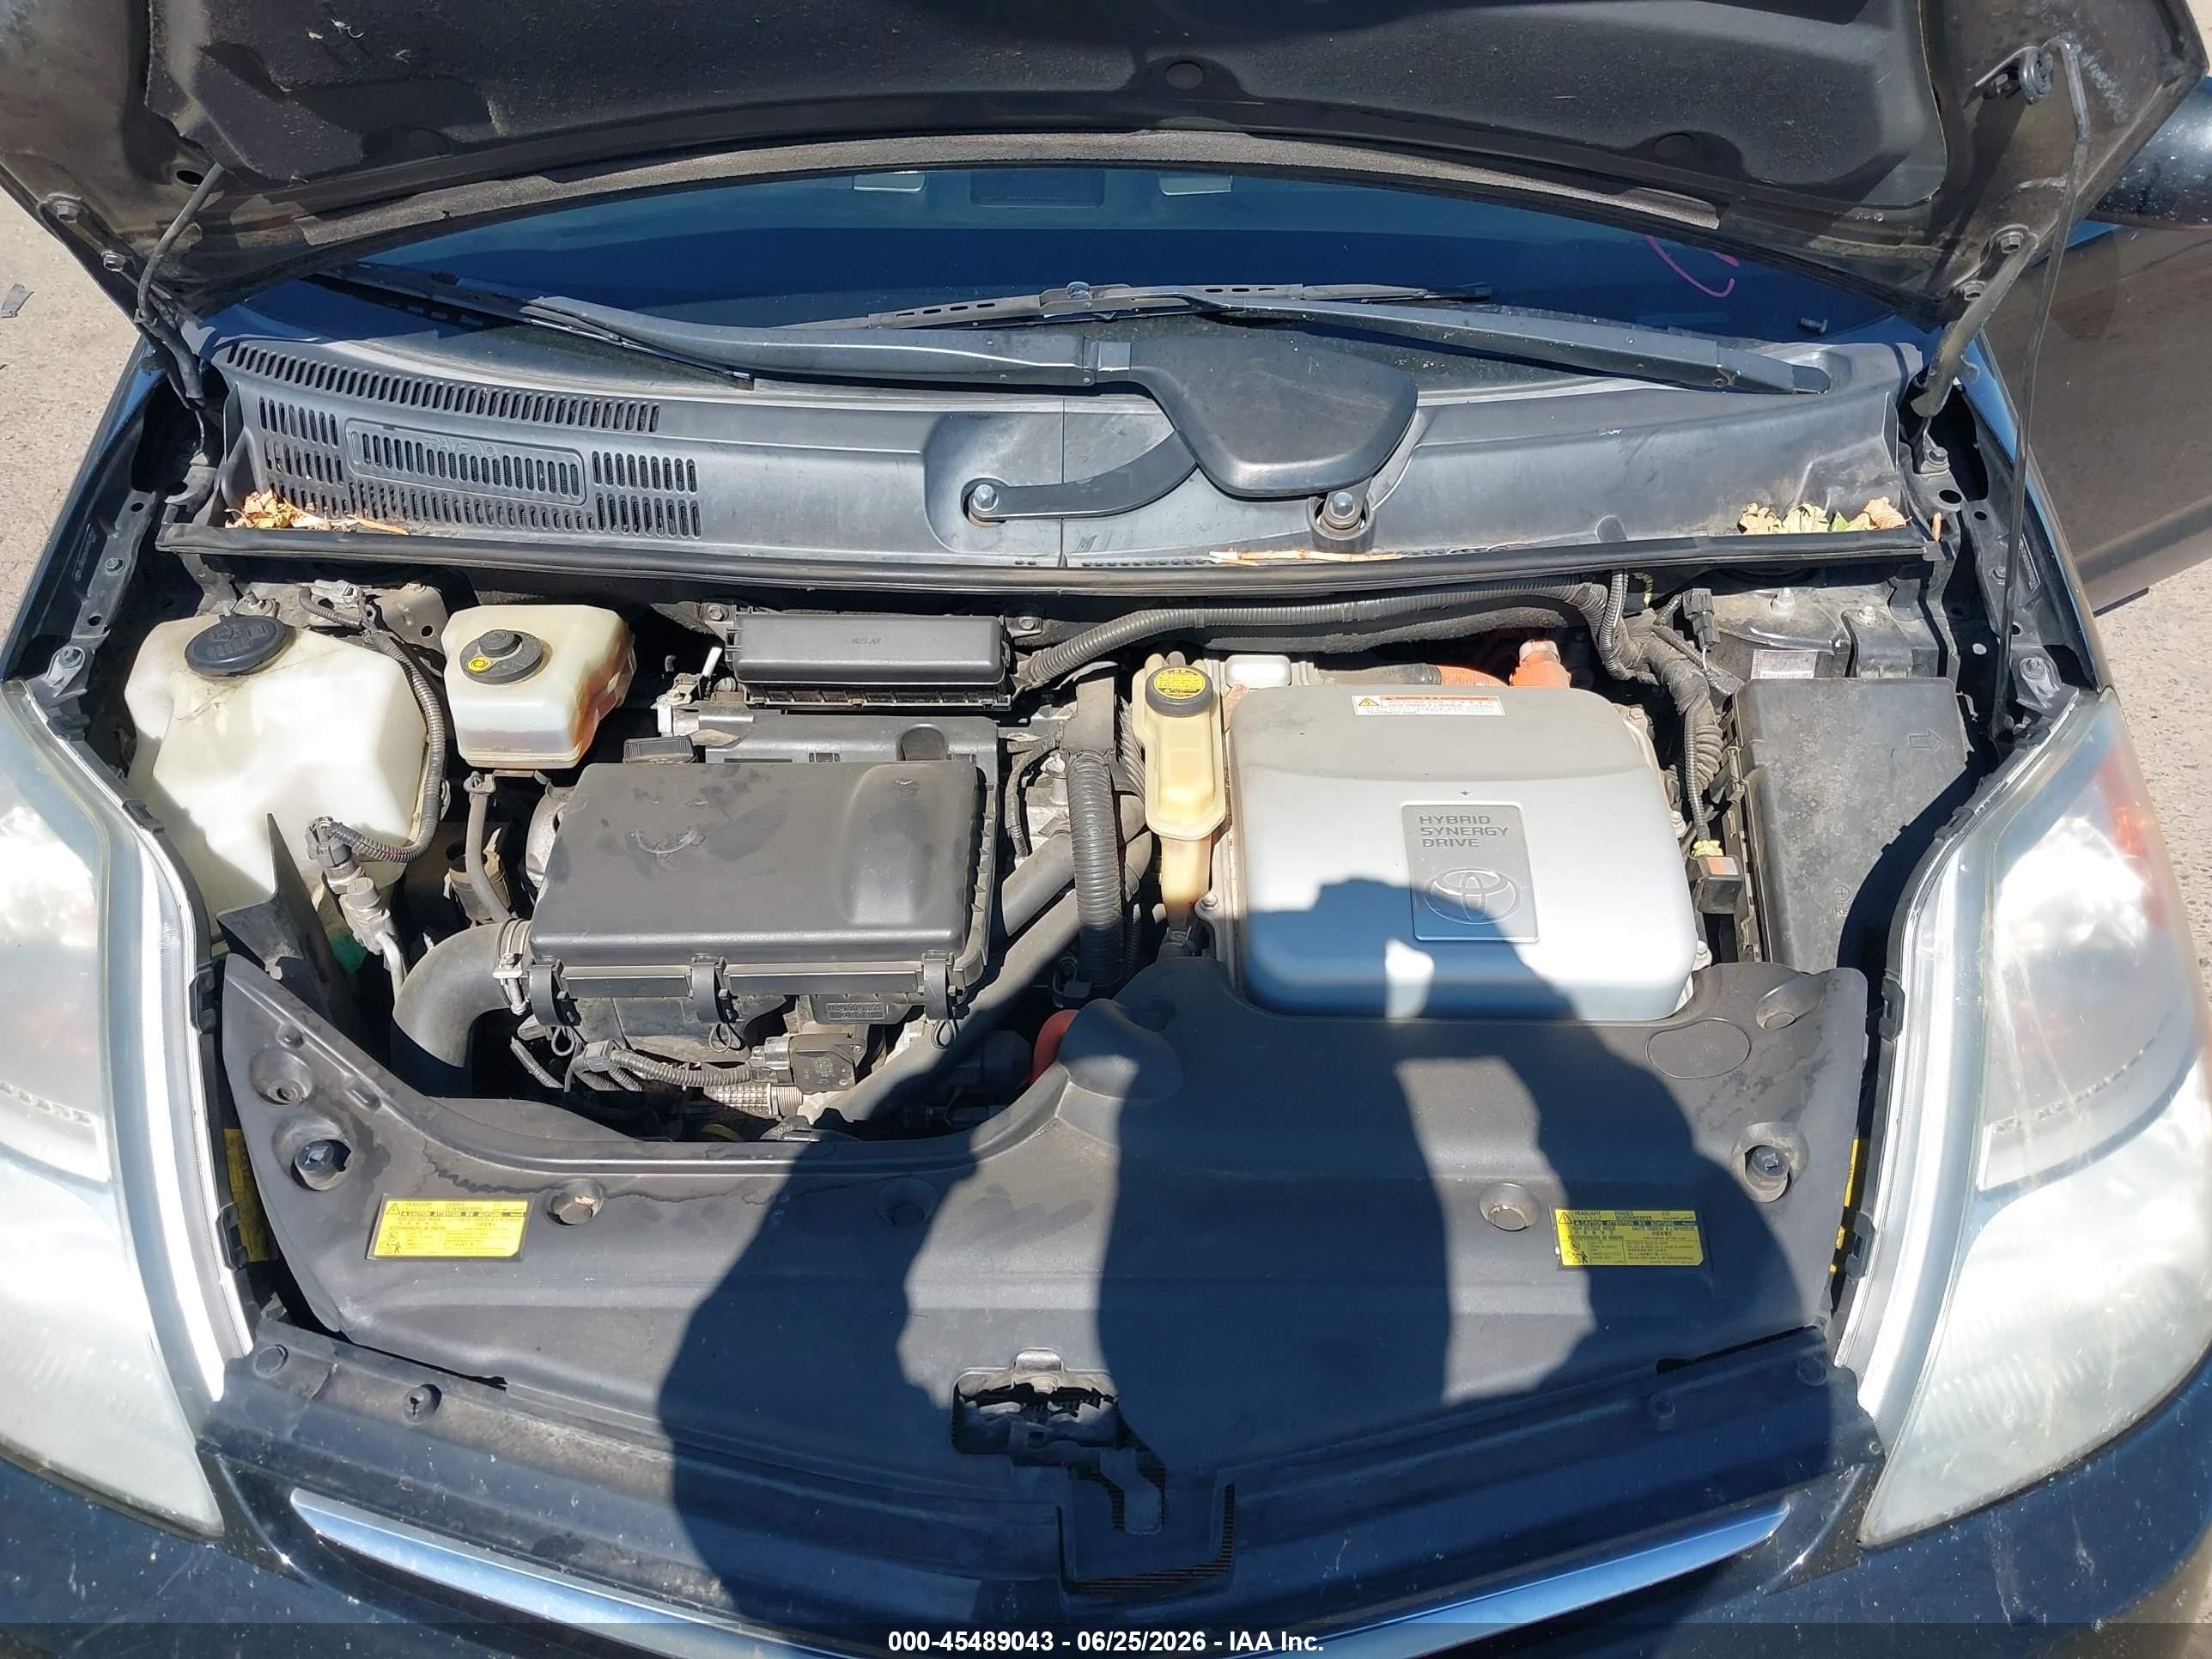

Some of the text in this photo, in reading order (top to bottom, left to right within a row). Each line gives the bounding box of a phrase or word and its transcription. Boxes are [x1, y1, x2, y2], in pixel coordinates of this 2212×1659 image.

[1419, 815, 1491, 824] HYBRID
[1420, 826, 1510, 836] SYNERGY
[1421, 838, 1480, 848] DRIVE
